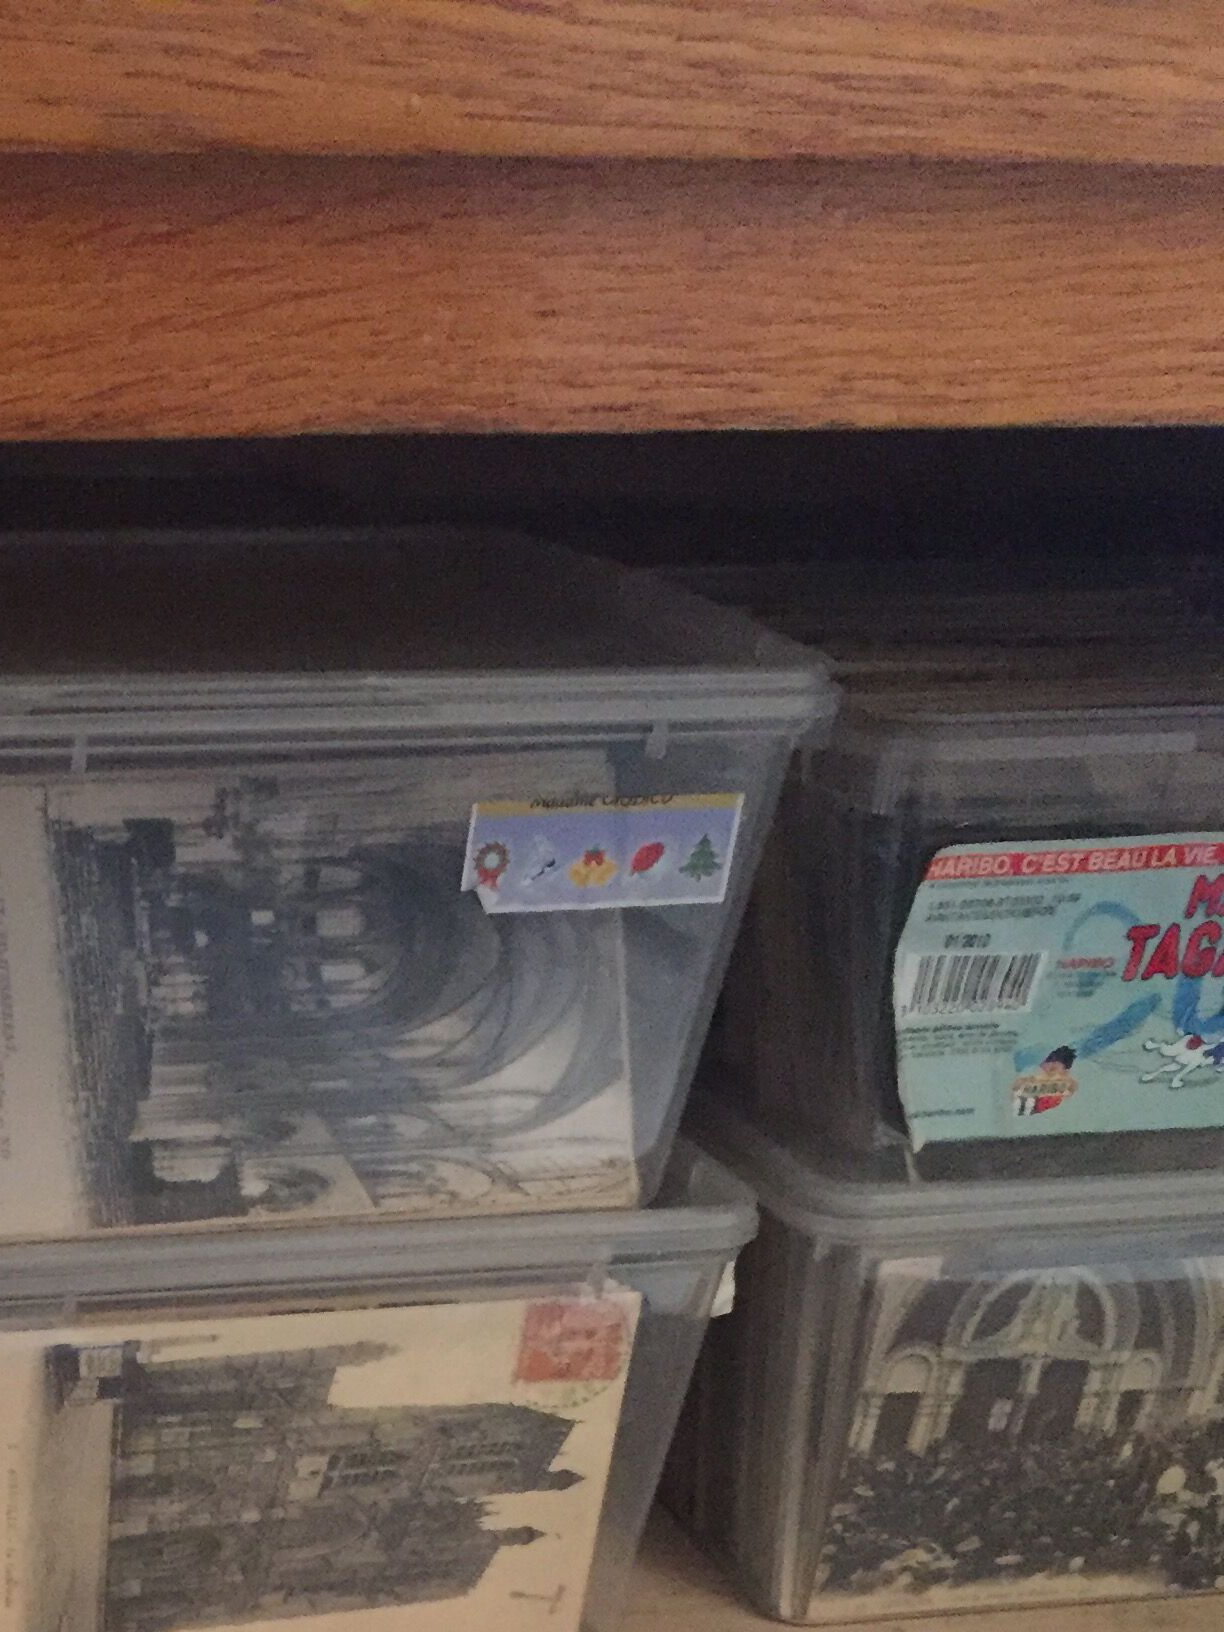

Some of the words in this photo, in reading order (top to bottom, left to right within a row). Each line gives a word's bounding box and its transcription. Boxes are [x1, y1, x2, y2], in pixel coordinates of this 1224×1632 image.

[1021, 851, 1089, 874] C'EST
[1087, 848, 1144, 870] BEAU
[1150, 846, 1177, 867] LA
[1183, 845, 1218, 864] VIE
[1184, 873, 1224, 919] M
[1121, 919, 1224, 982] TAG
